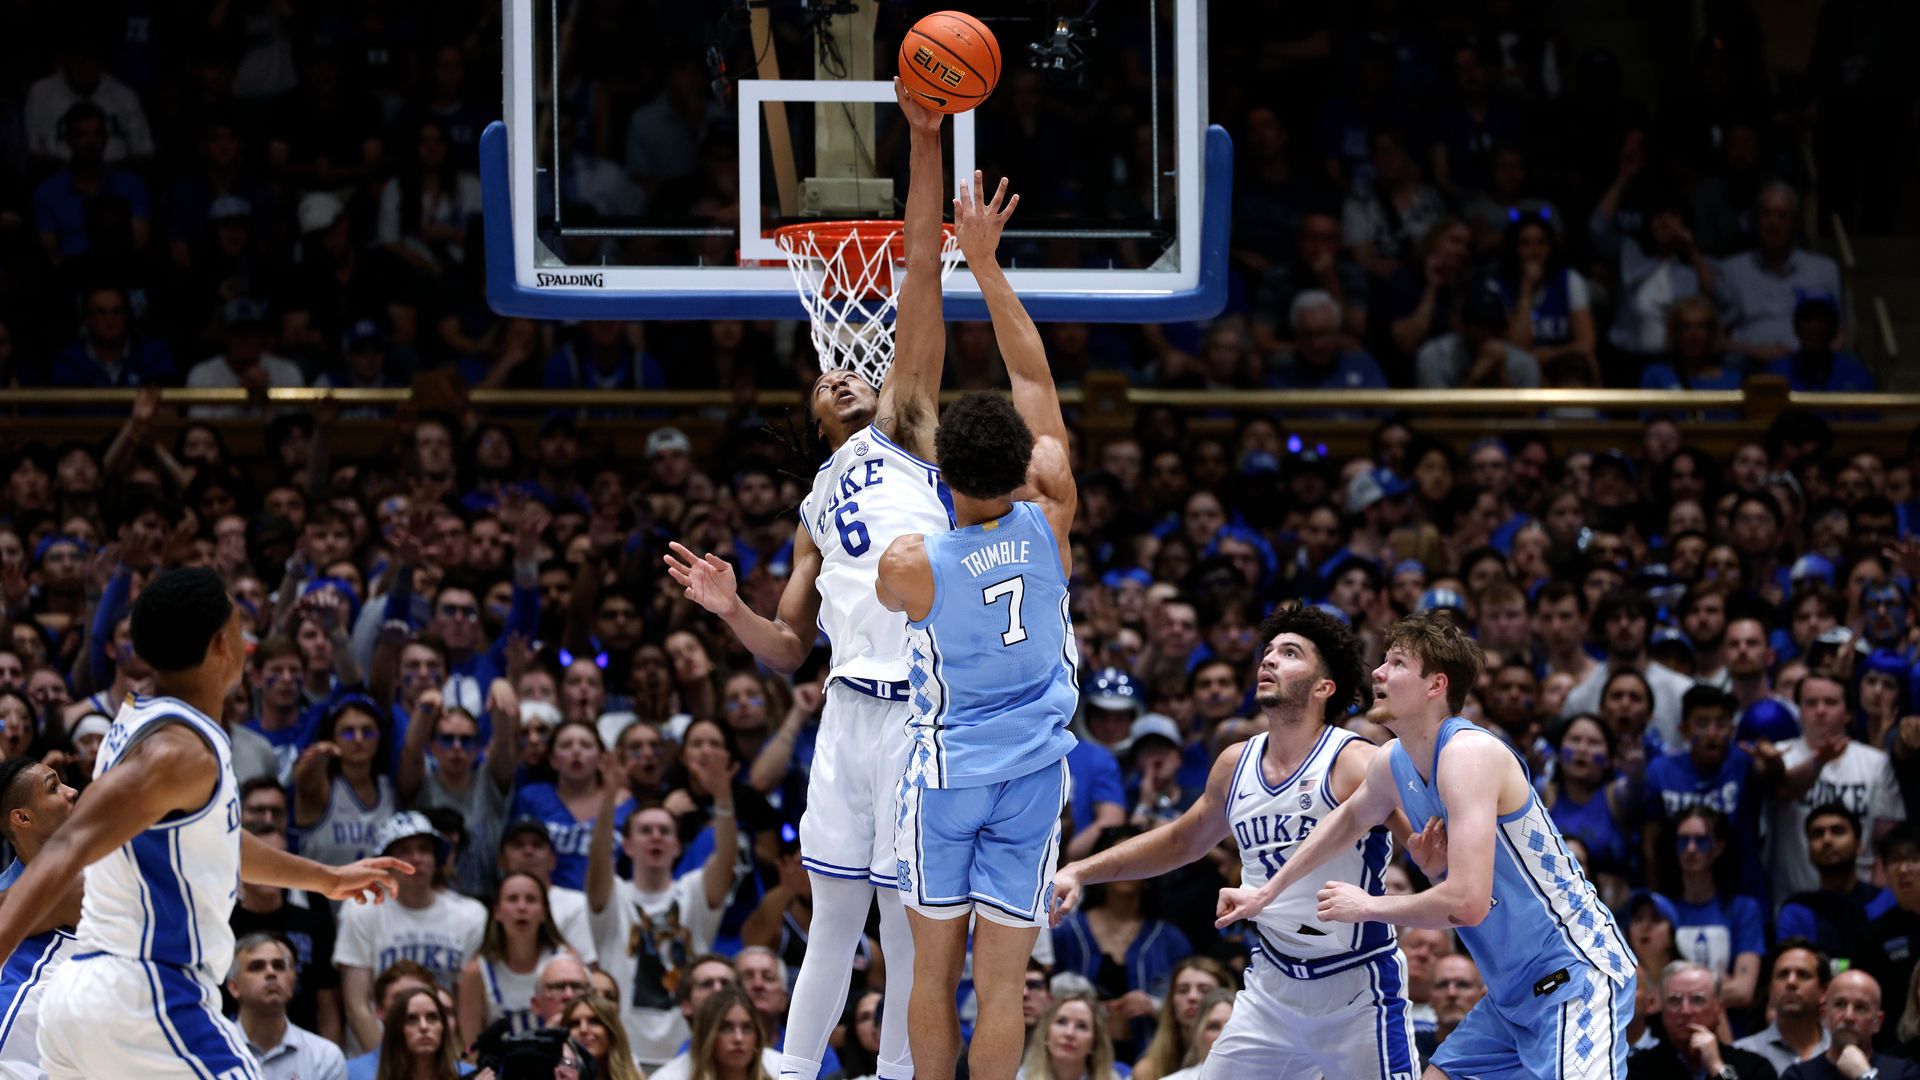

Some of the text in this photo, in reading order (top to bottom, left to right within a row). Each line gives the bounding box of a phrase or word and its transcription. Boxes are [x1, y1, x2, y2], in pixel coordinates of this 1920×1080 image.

[912, 48, 963, 89] ELITE
[536, 272, 604, 288] SPALDING
[818, 458, 884, 534] DUKE
[834, 501, 871, 558] 6
[960, 540, 1030, 578] TRIMBLE
[982, 574, 1028, 647] 7
[876, 680, 891, 699] D
[1235, 814, 1318, 850] DUKE
